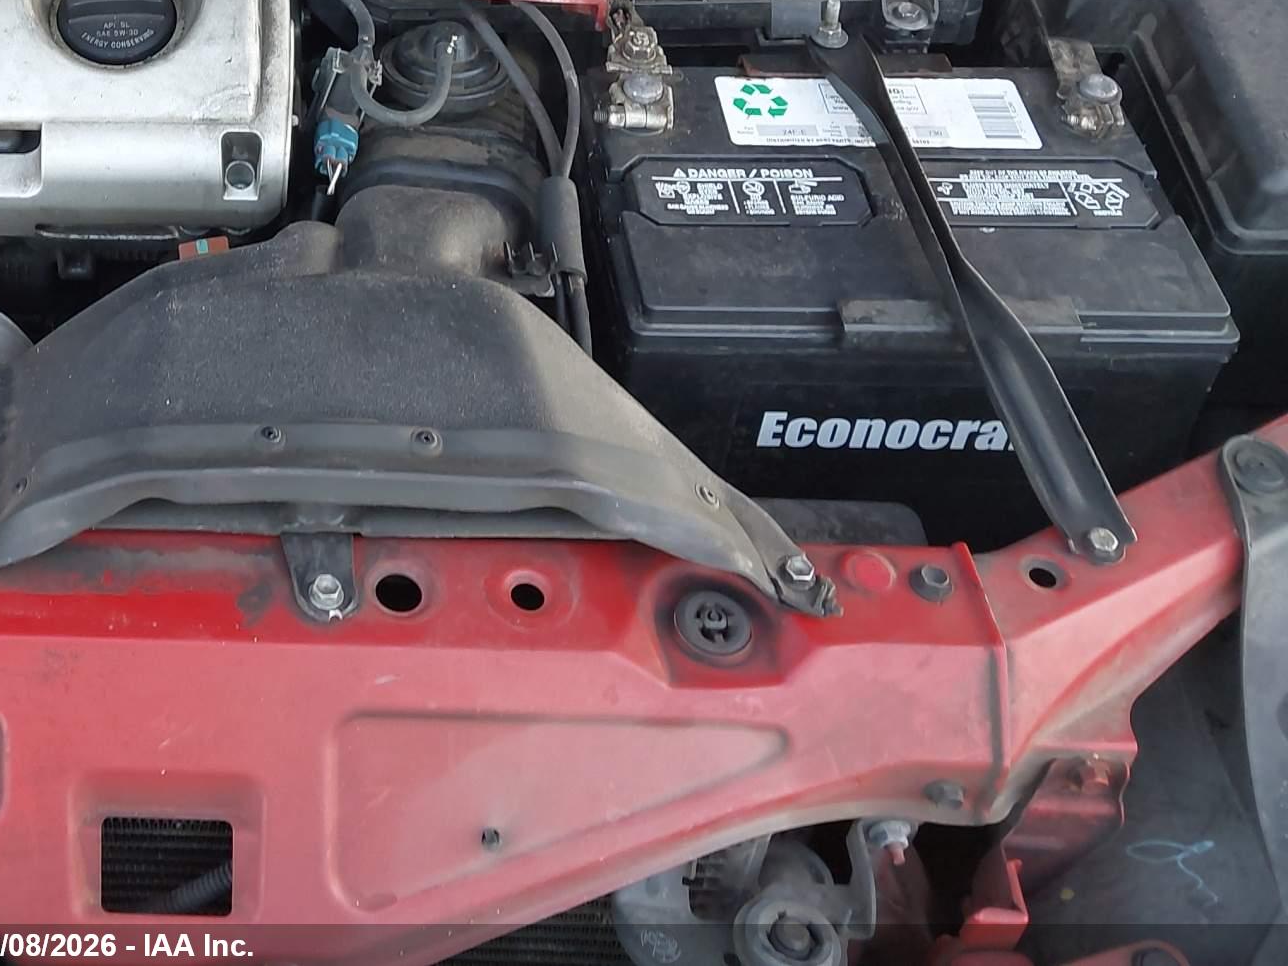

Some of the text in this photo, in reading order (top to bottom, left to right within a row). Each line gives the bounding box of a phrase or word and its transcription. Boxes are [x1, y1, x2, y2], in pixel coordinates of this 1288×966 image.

[687, 168, 746, 178] DANGER
[760, 168, 814, 178] POISON
[756, 411, 1015, 451] Econocra
